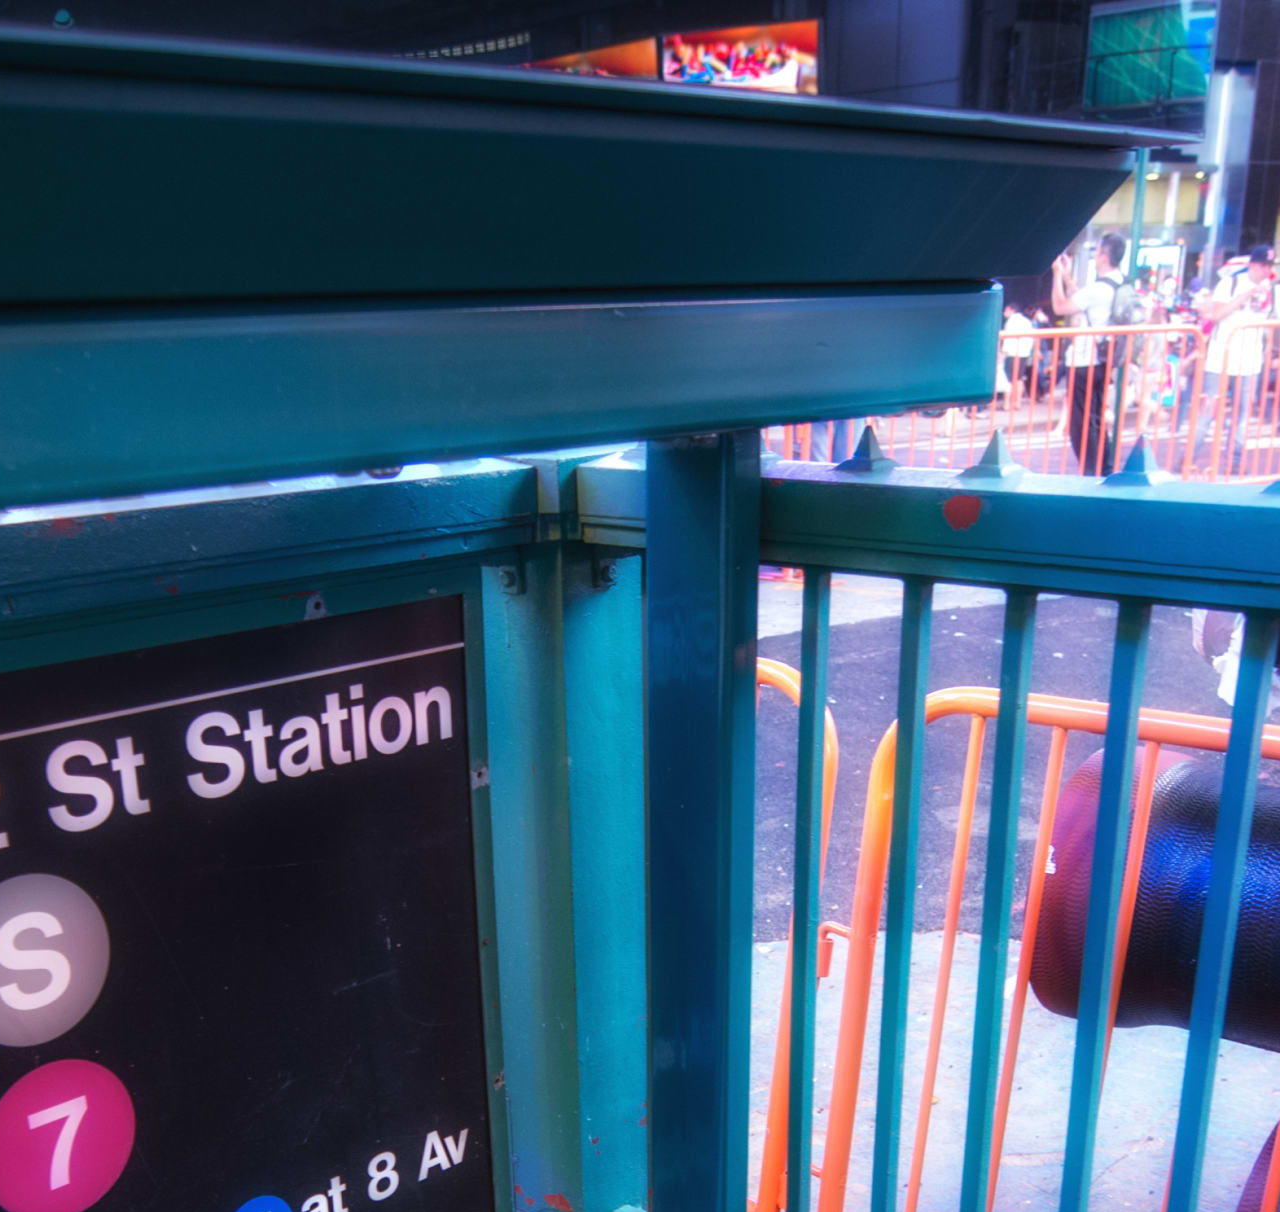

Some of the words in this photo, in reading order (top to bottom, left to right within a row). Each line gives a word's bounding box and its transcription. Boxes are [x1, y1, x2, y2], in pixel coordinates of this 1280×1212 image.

[46, 736, 151, 832] St
[186, 683, 453, 799] Station
[366, 1151, 401, 1202] 8
[417, 1127, 469, 1182] Av
